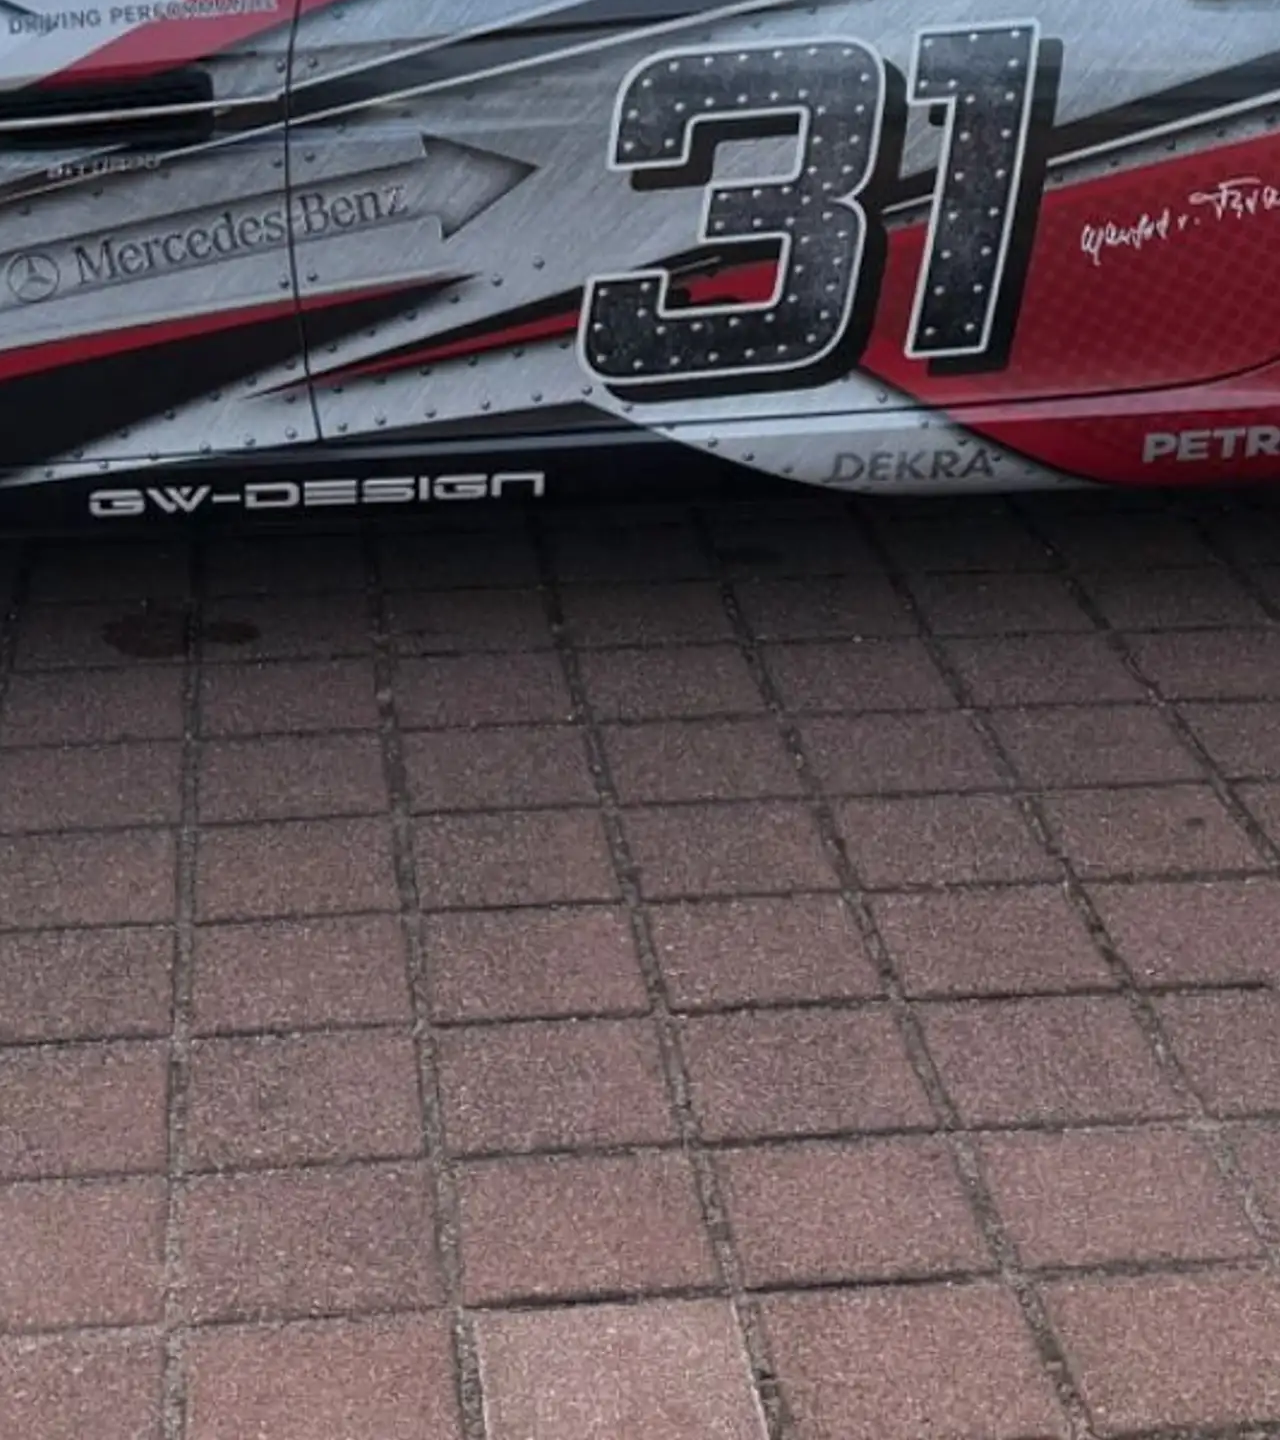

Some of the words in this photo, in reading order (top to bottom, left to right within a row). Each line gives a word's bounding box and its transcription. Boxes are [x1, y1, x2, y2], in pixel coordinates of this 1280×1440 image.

[8, 9, 102, 35] DRIVING
[577, 17, 1058, 400] 31
[822, 448, 995, 484] DEKRA
[89, 471, 546, 518] GW-DESIGN
